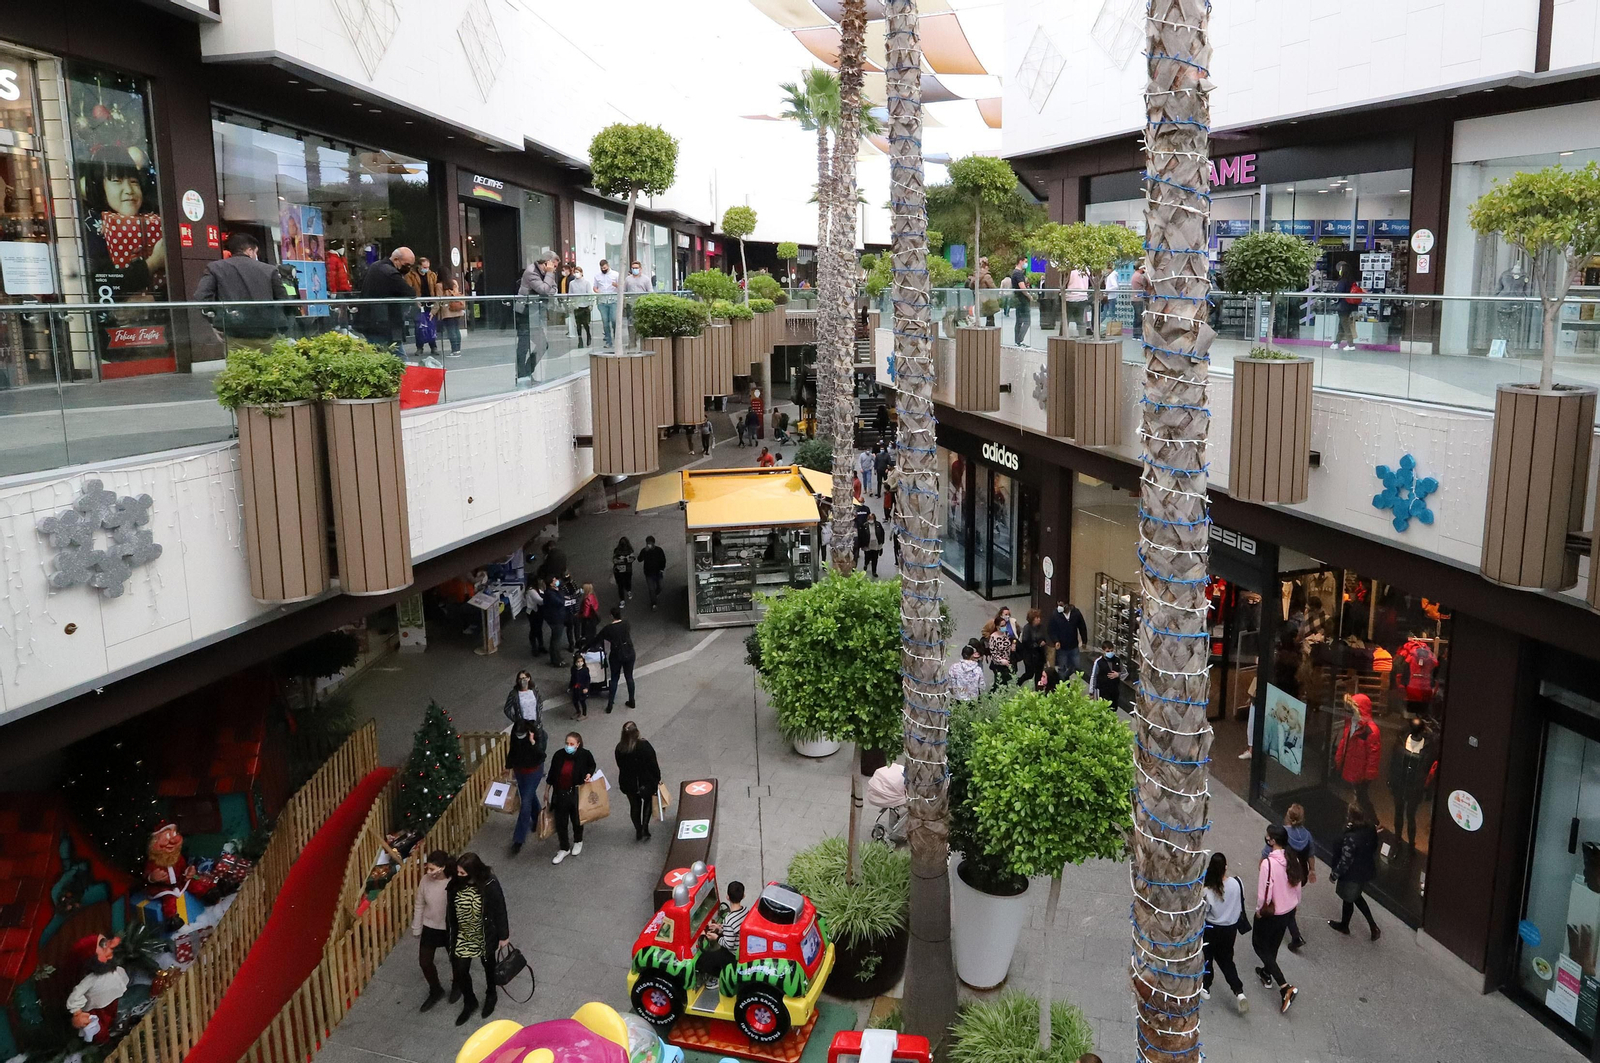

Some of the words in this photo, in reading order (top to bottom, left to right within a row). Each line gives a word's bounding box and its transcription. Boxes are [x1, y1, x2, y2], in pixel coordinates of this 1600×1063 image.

[473, 174, 504, 190] DECIMAS
[1209, 154, 1256, 187] AME
[114, 329, 136, 342] Felices
[138, 328, 160, 341] Fiestas
[982, 442, 1019, 470] adidas
[1209, 523, 1257, 555] esia
